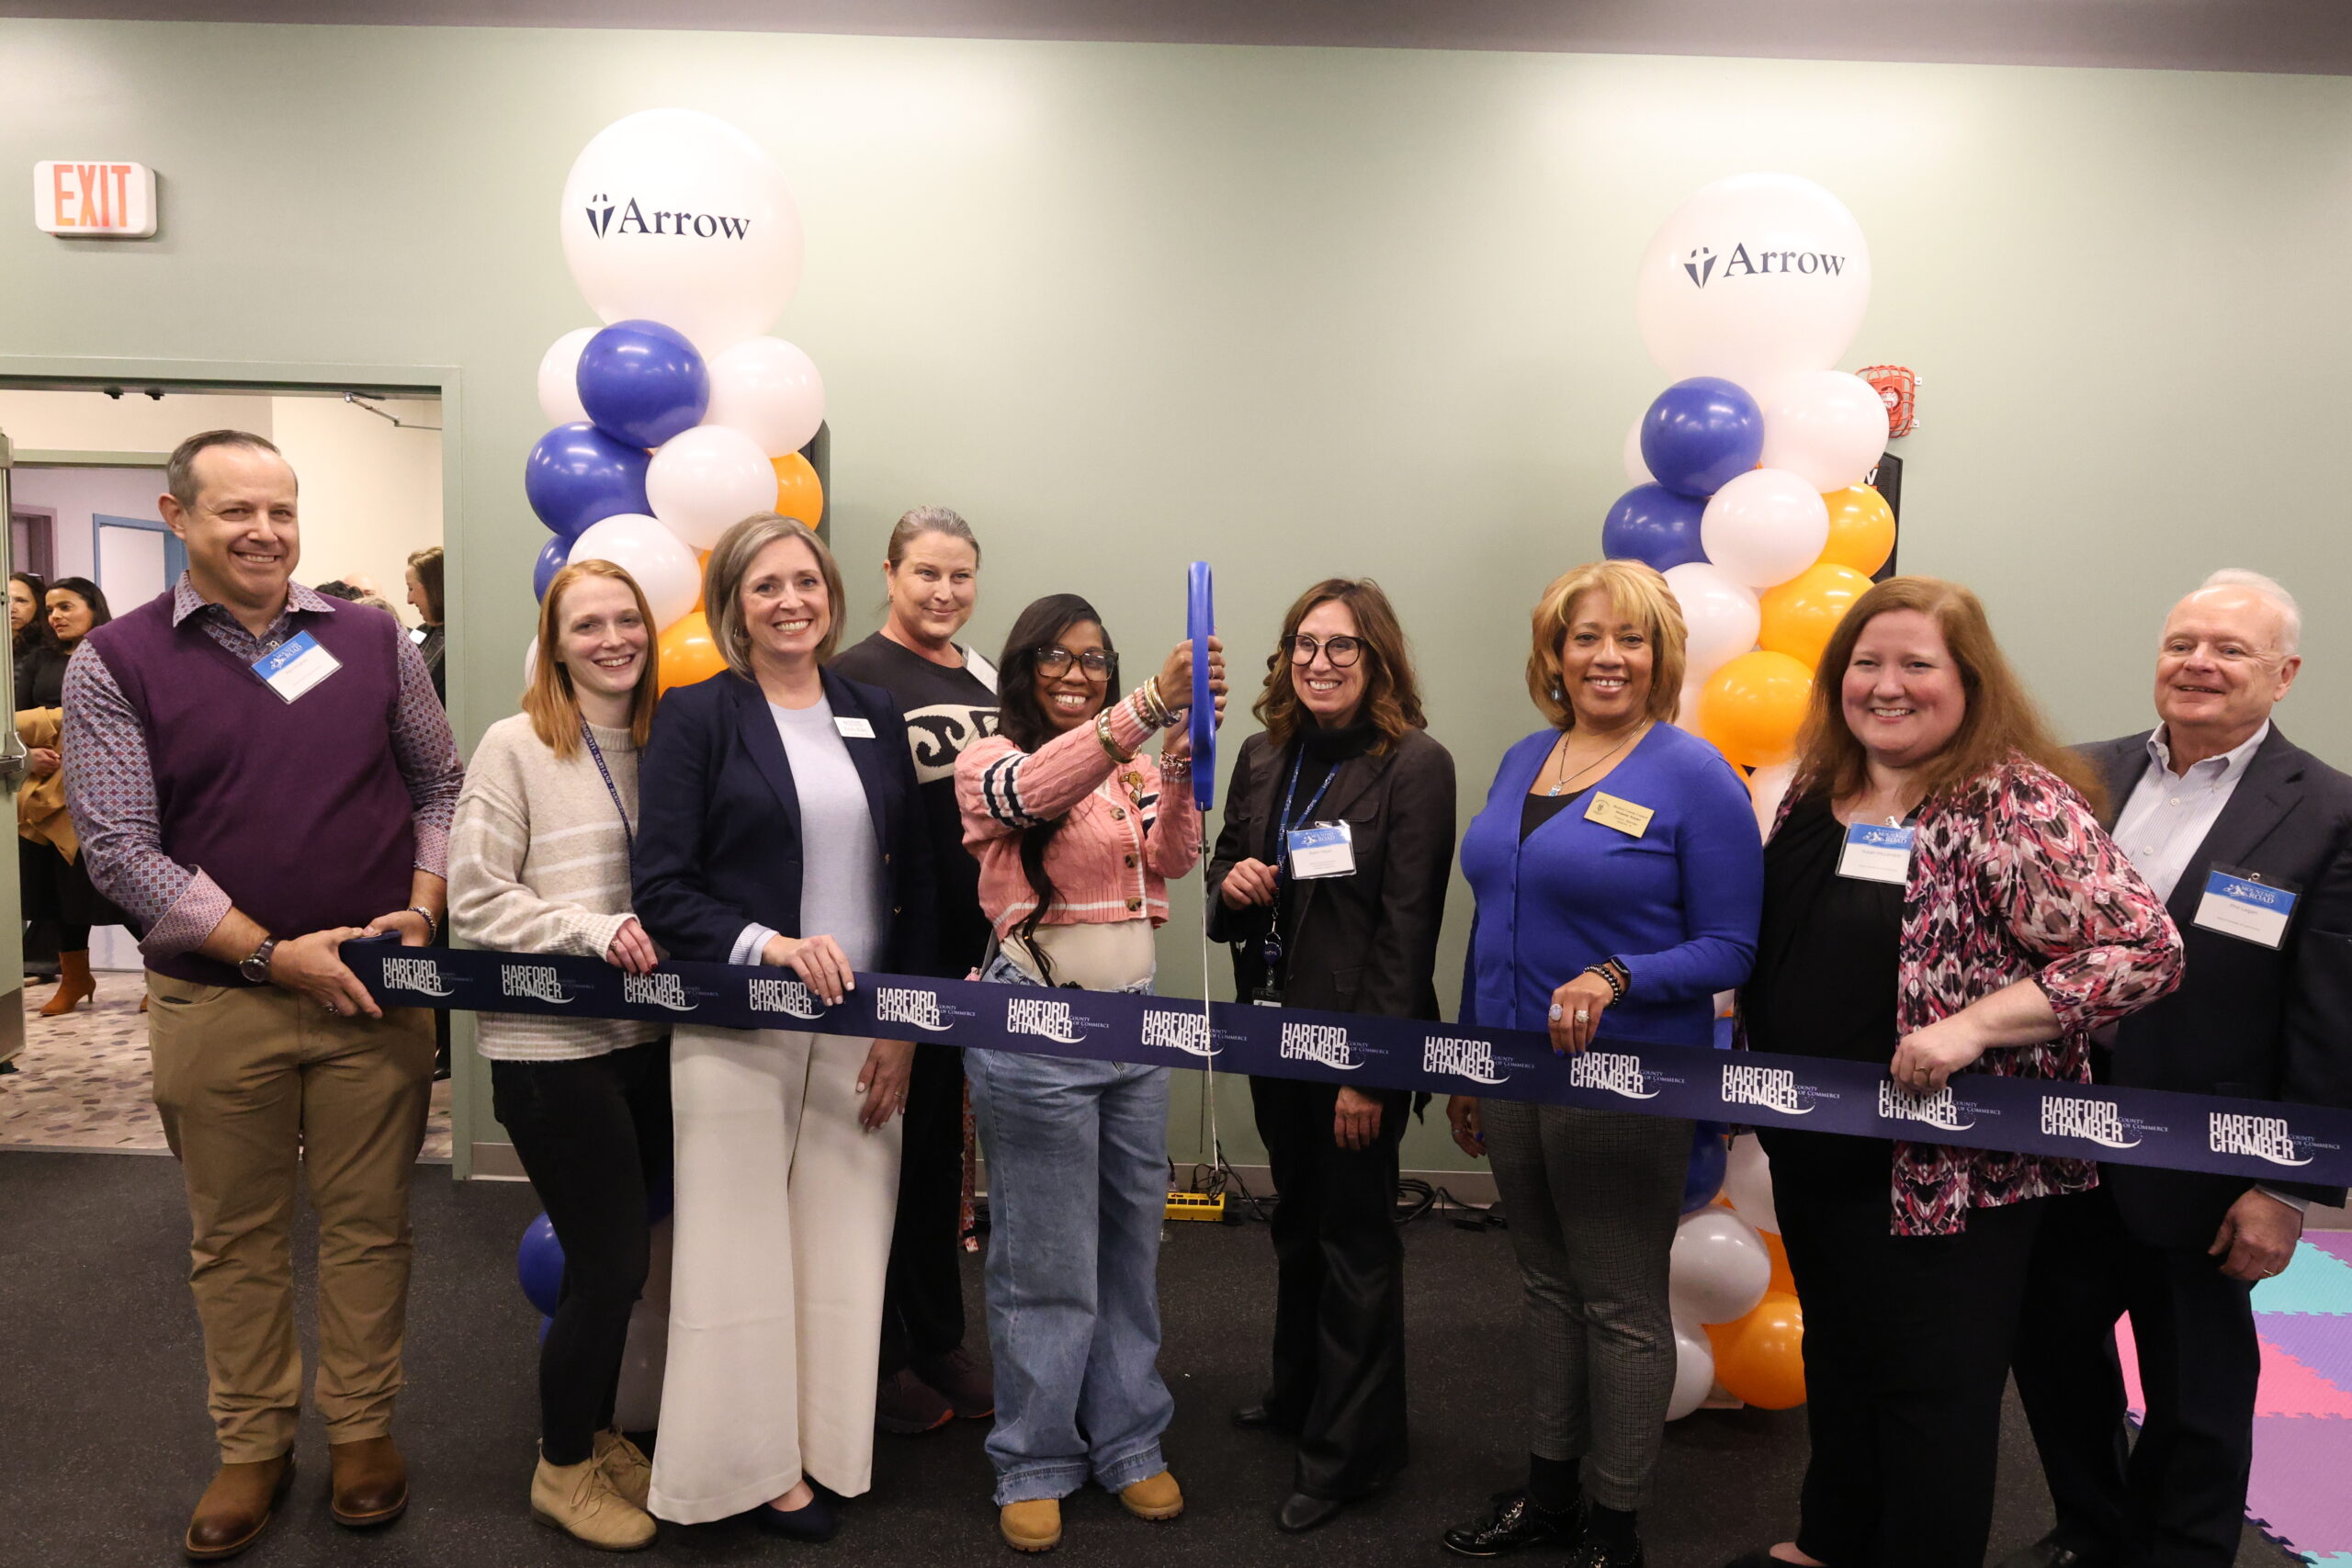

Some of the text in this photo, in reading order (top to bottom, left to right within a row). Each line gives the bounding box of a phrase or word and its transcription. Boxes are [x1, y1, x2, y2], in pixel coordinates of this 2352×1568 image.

[53, 164, 131, 227] EXIT
[617, 197, 751, 241] Arrow
[1723, 243, 1846, 278] Arrow
[2248, 892, 2274, 904] ROAD
[383, 957, 436, 976] HARFORD
[502, 964, 557, 983] HARFORD
[383, 973, 442, 991] CHAMBER
[503, 979, 562, 998] CHAMBER
[749, 978, 807, 997] HARFORD
[624, 987, 685, 1007] CHAMBER
[750, 994, 812, 1014] CHAMBER
[876, 987, 937, 1009] HARFORD
[876, 1003, 941, 1025] CHAMBER
[1008, 998, 1069, 1021] HARFORD
[1144, 1009, 1207, 1032] HARFORD
[1007, 1014, 1073, 1038] CHAMBER
[1282, 1021, 1347, 1045] HARFORD
[1141, 1026, 1210, 1051] CHAMBER
[1424, 1035, 1492, 1060] HARFORD
[1280, 1040, 1351, 1064] CHAMBER
[1358, 1047, 1389, 1055] COMMERCE
[1423, 1053, 1495, 1078] CHAMBER
[1503, 1061, 1534, 1069] COMMERCE
[1723, 1064, 1793, 1089] HARFORD
[1570, 1068, 1644, 1093] CHAMBER
[1722, 1082, 1797, 1108] CHAMBER
[1806, 1090, 1839, 1099] COMMERCE
[1951, 1099, 1977, 1107] COUNTY
[1878, 1099, 1957, 1124] CHAMBER
[1966, 1106, 2001, 1115] COMMERCE
[2041, 1095, 2118, 1122] HARFORD
[2117, 1116, 2144, 1124] COUNTY
[2041, 1113, 2123, 1143] CHAMBER
[2132, 1123, 2168, 1132] COMMERCE
[2209, 1111, 2288, 1139] HARFORD
[2209, 1132, 2295, 1159] CHAMBER
[2303, 1141, 2340, 1150] COMMERCE
